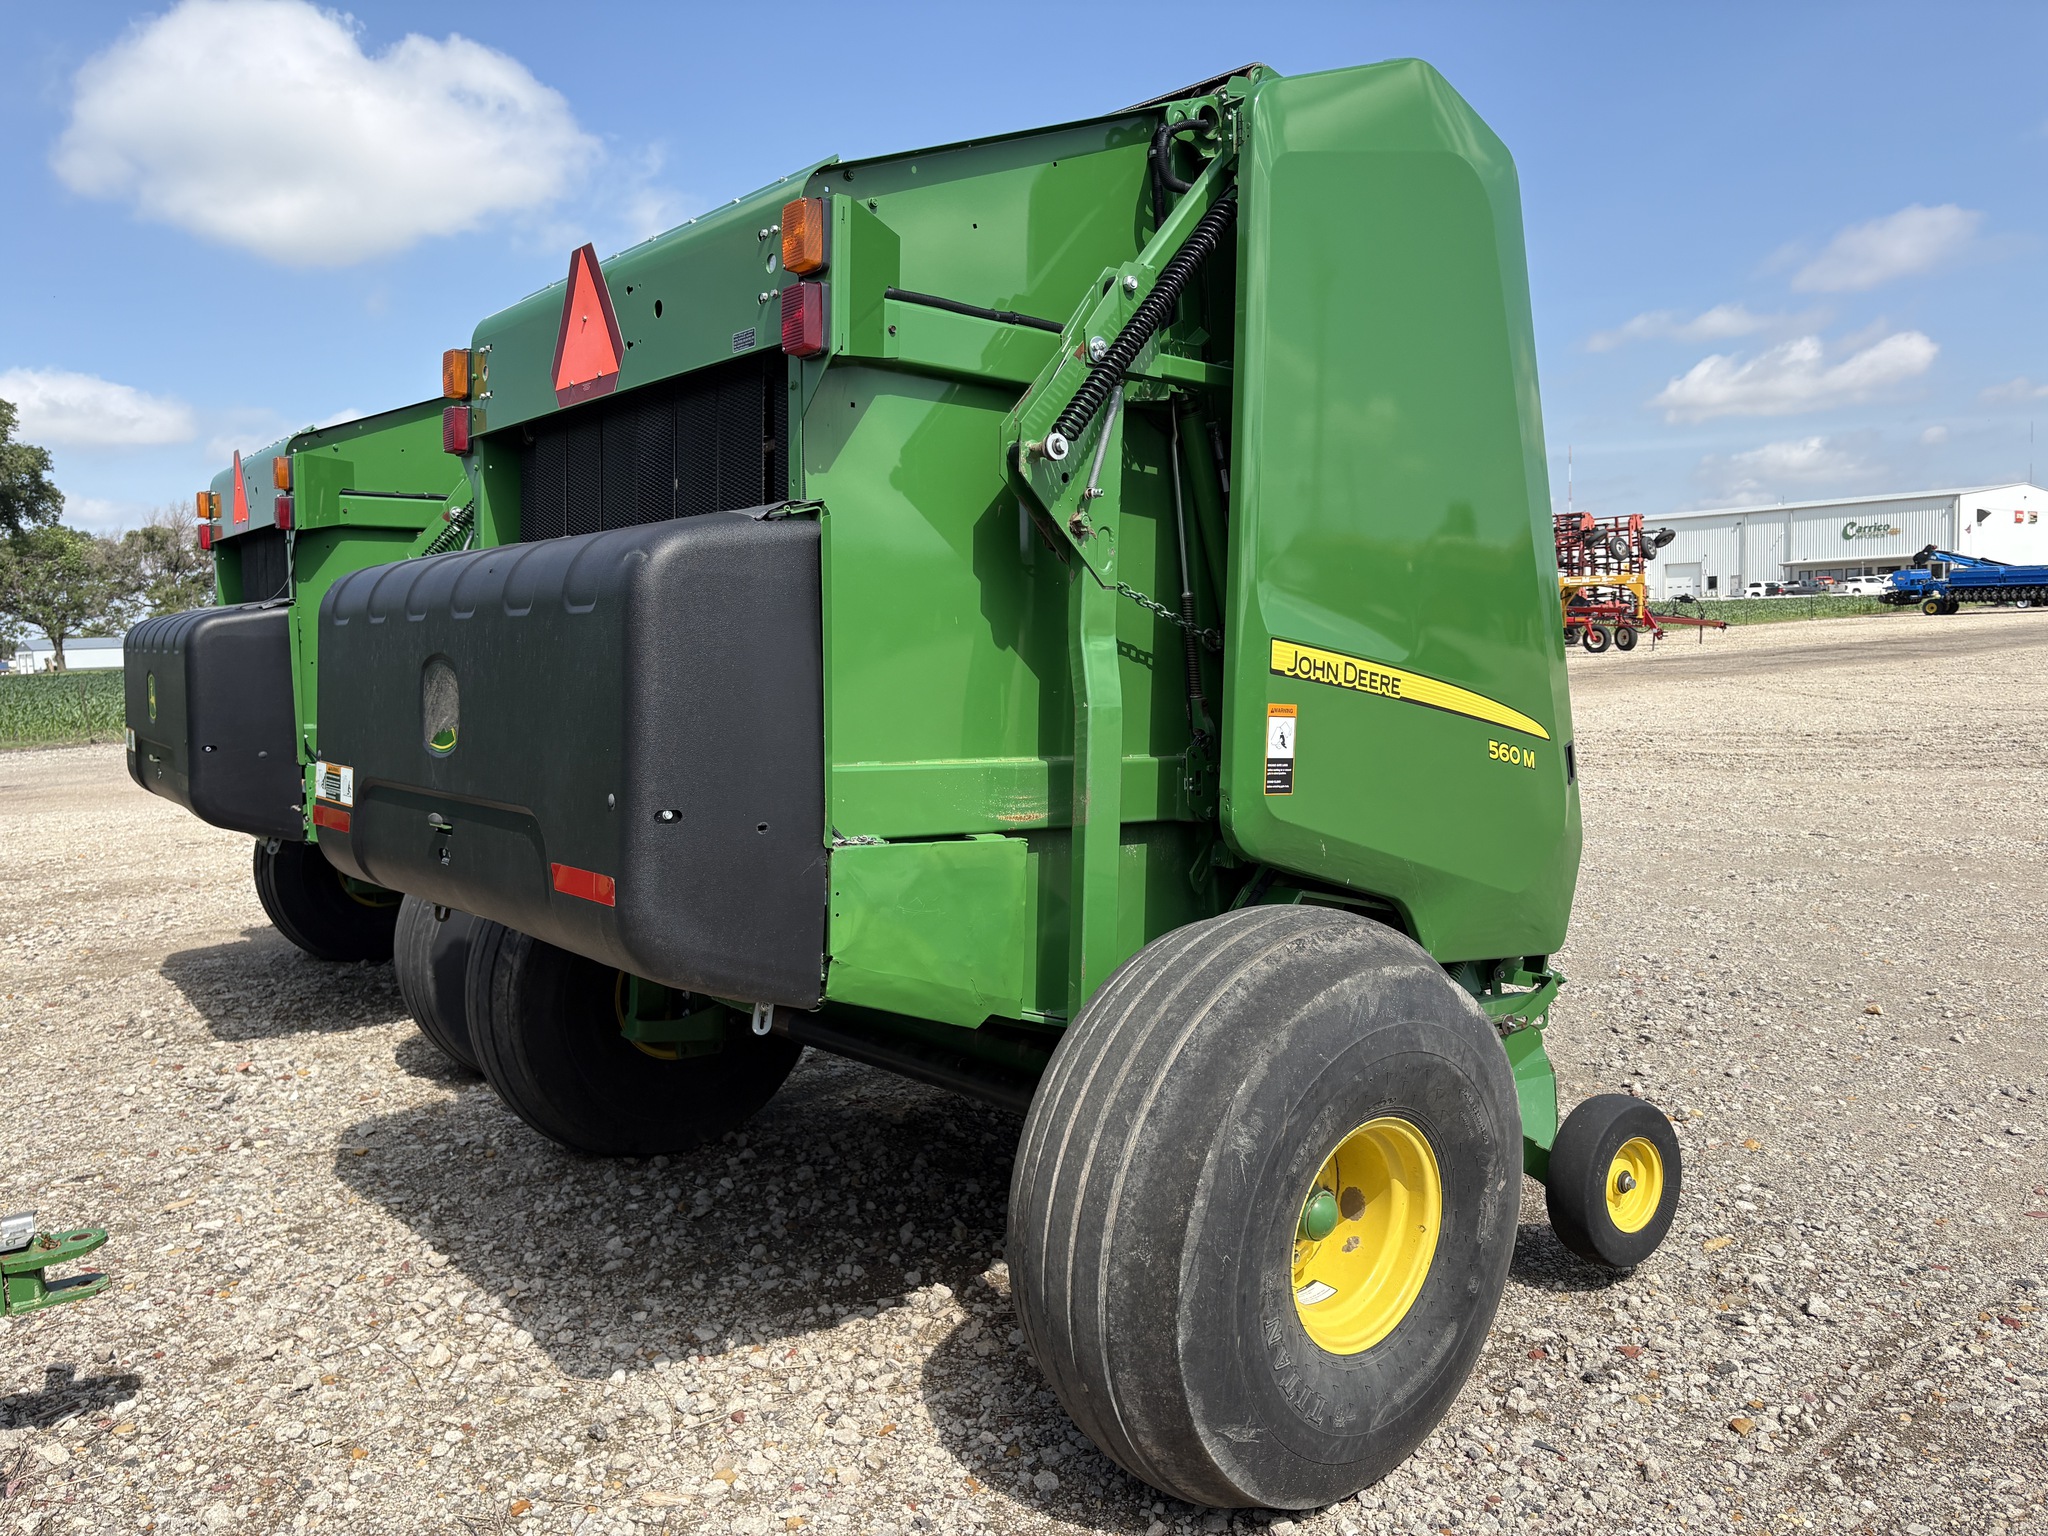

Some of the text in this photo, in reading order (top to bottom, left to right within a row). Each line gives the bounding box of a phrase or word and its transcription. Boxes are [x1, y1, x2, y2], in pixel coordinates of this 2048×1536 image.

[1842, 521, 1891, 540] Carrico
[1287, 650, 1402, 696] JOHN DEERE
[1488, 738, 1536, 770] 560 M
[1263, 1316, 1328, 1428] TITAN
